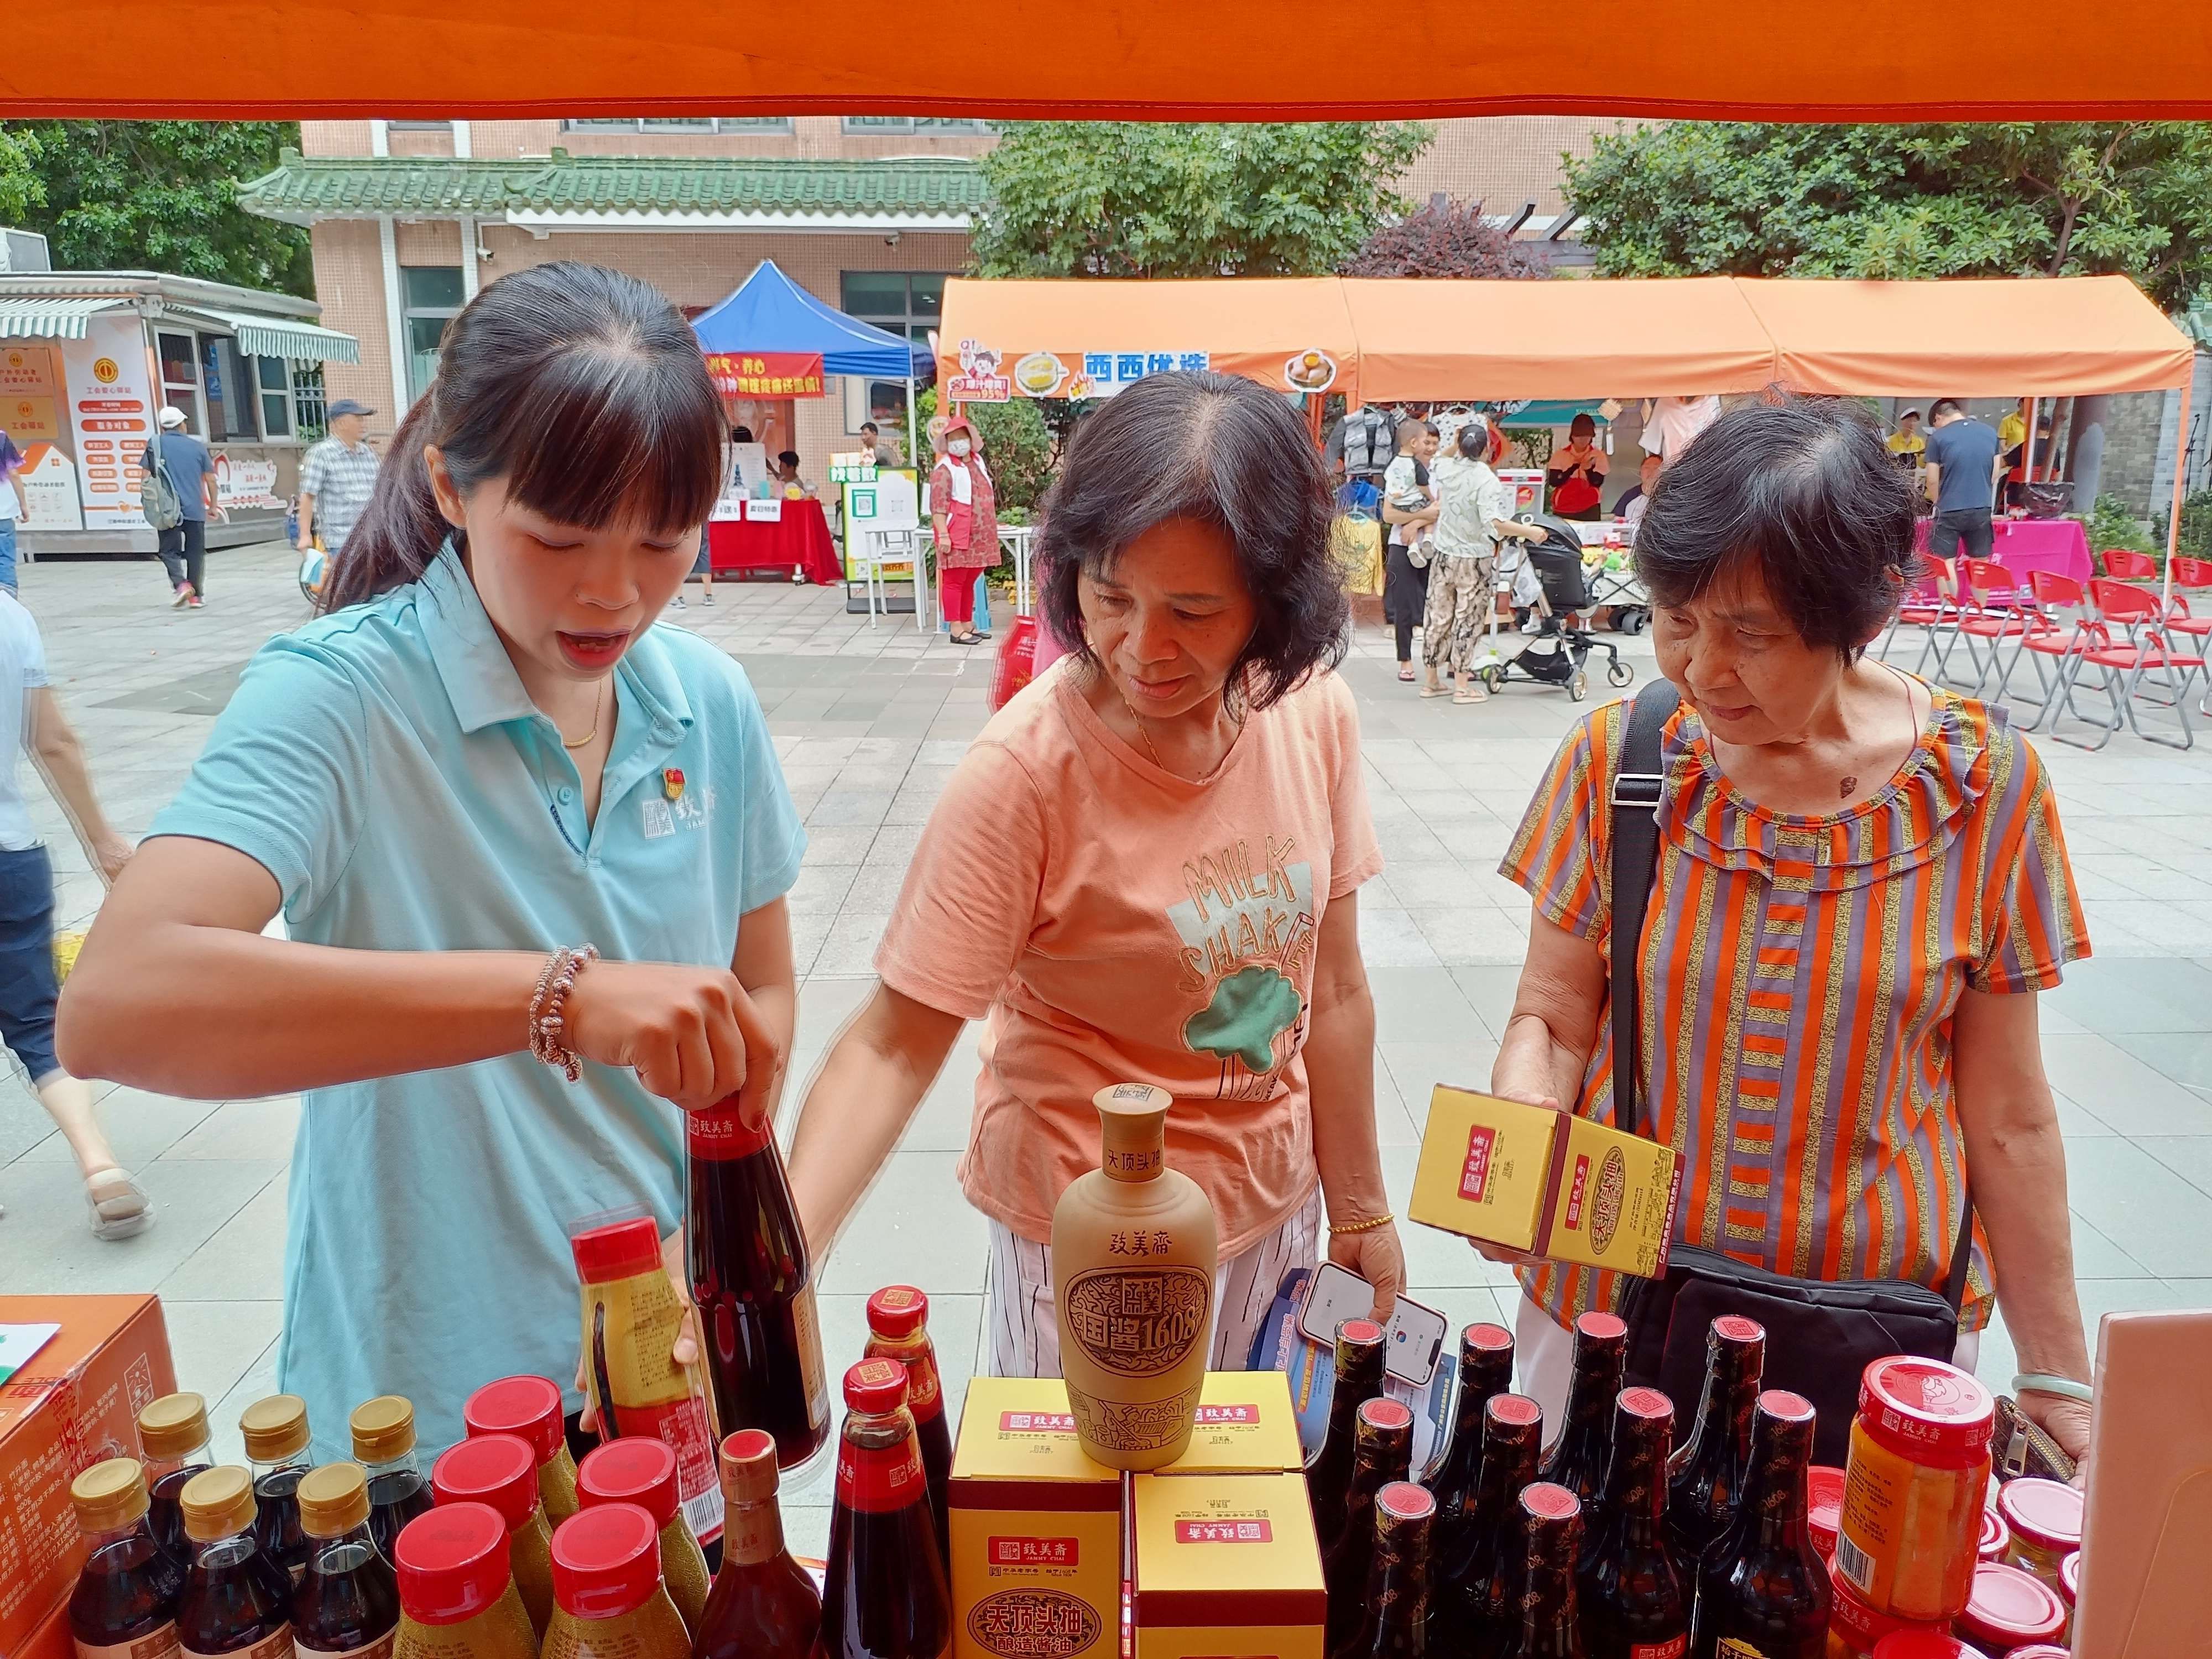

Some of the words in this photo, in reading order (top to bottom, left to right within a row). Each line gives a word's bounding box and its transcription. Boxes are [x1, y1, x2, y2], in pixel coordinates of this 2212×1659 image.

[1086, 354, 1207, 382] 西西优选
[982, 389, 1005, 398] 95%
[1182, 835, 1296, 922] MILK
[1177, 907, 1314, 993] SHAKE
[700, 1120, 733, 1133] 致美斋
[1108, 1149, 1160, 1171] 天顶头抽
[1034, 1415, 1074, 1427] 致美斋
[1206, 1408, 1248, 1417] 致美斋
[1902, 1418, 1941, 1440] 致美斋
[1764, 1489, 1786, 1508] 1608
[1382, 1515, 1402, 1532] 1608
[1526, 1515, 1547, 1532] 1608
[1187, 1527, 1235, 1539] 致美斋
[1023, 1542, 1067, 1556] 致美斋
[1520, 1590, 1541, 1608] 1608
[987, 1604, 1082, 1634] 天顶头抽
[1839, 1603, 1871, 1629] 致美斋
[997, 1636, 1073, 1652] 酿造酱油
